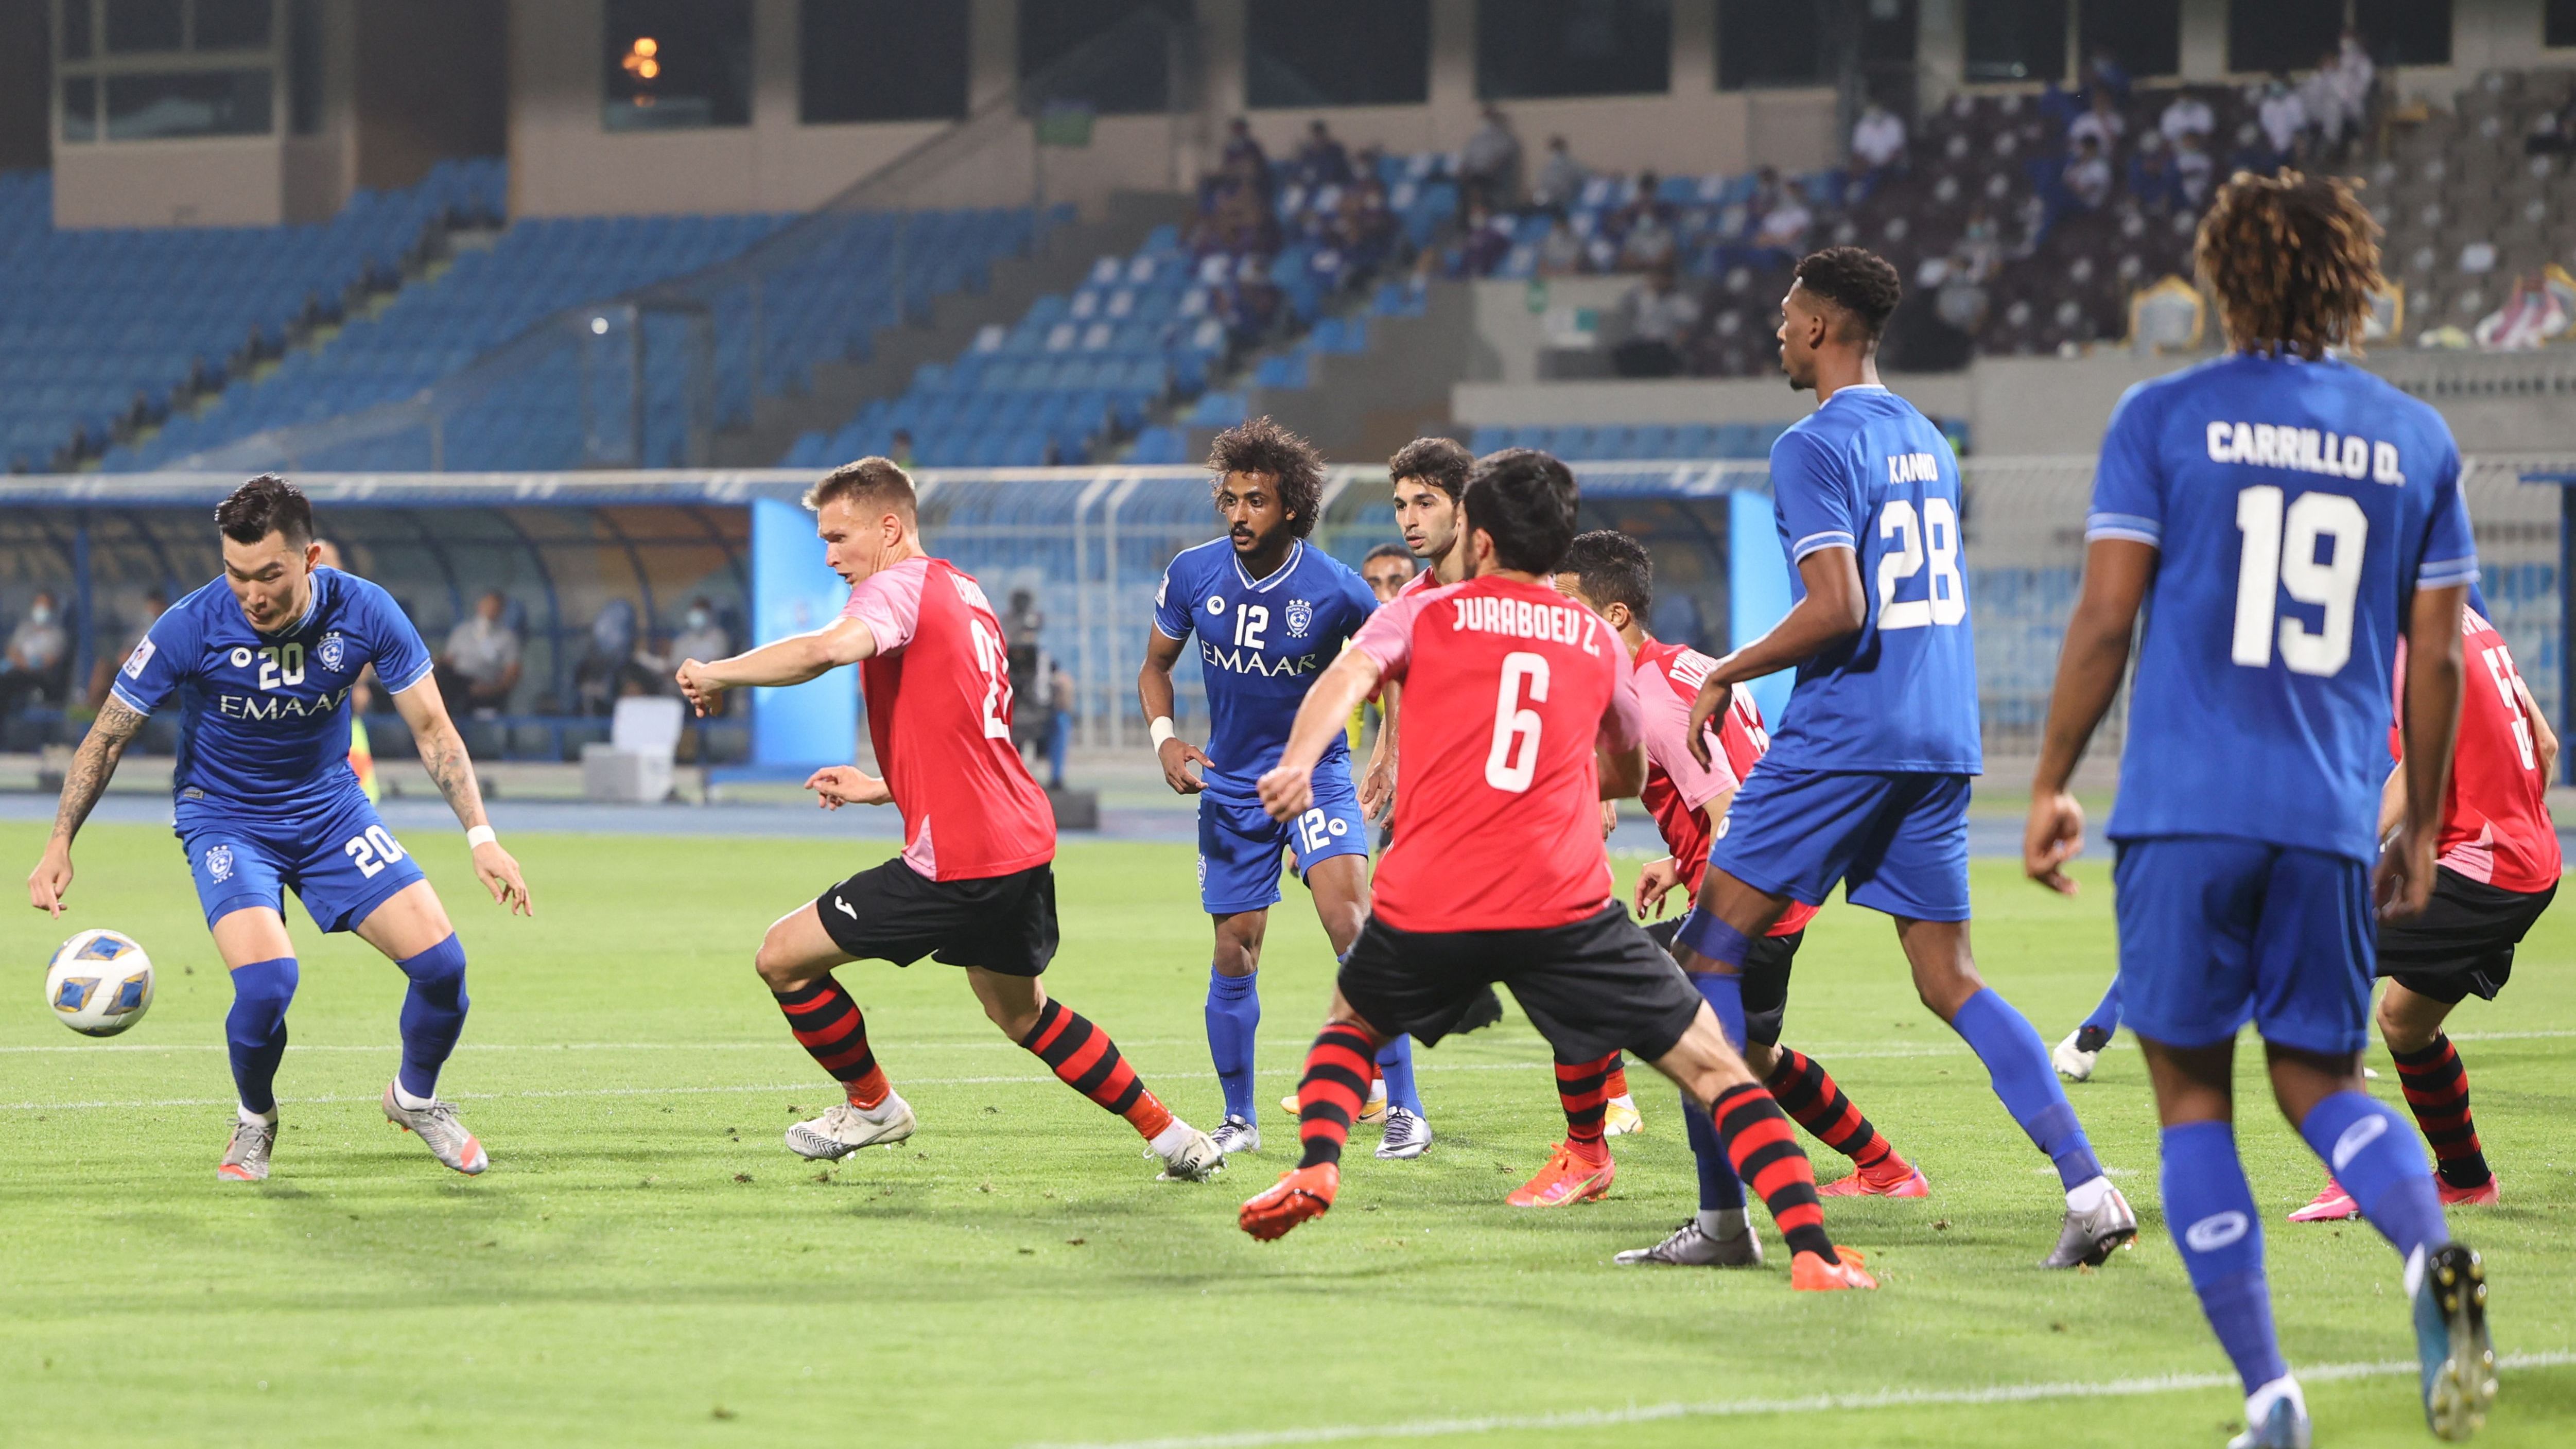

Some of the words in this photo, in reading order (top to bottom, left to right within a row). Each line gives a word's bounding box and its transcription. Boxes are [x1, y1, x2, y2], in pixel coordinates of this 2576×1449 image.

[2206, 421, 2369, 480] CARRILLO
[2372, 440, 2406, 488] D.
[1876, 497, 1966, 630] 28
[2231, 484, 2369, 678] 19
[1234, 603, 1269, 650] 12
[1452, 596, 1579, 645] JURABOEV
[1582, 613, 1600, 658] Z.
[258, 642, 305, 690] 20
[1201, 639, 1316, 677] EMAAR
[1484, 651, 1551, 793] 6
[345, 824, 403, 880] 20
[1298, 807, 1331, 854] 12
